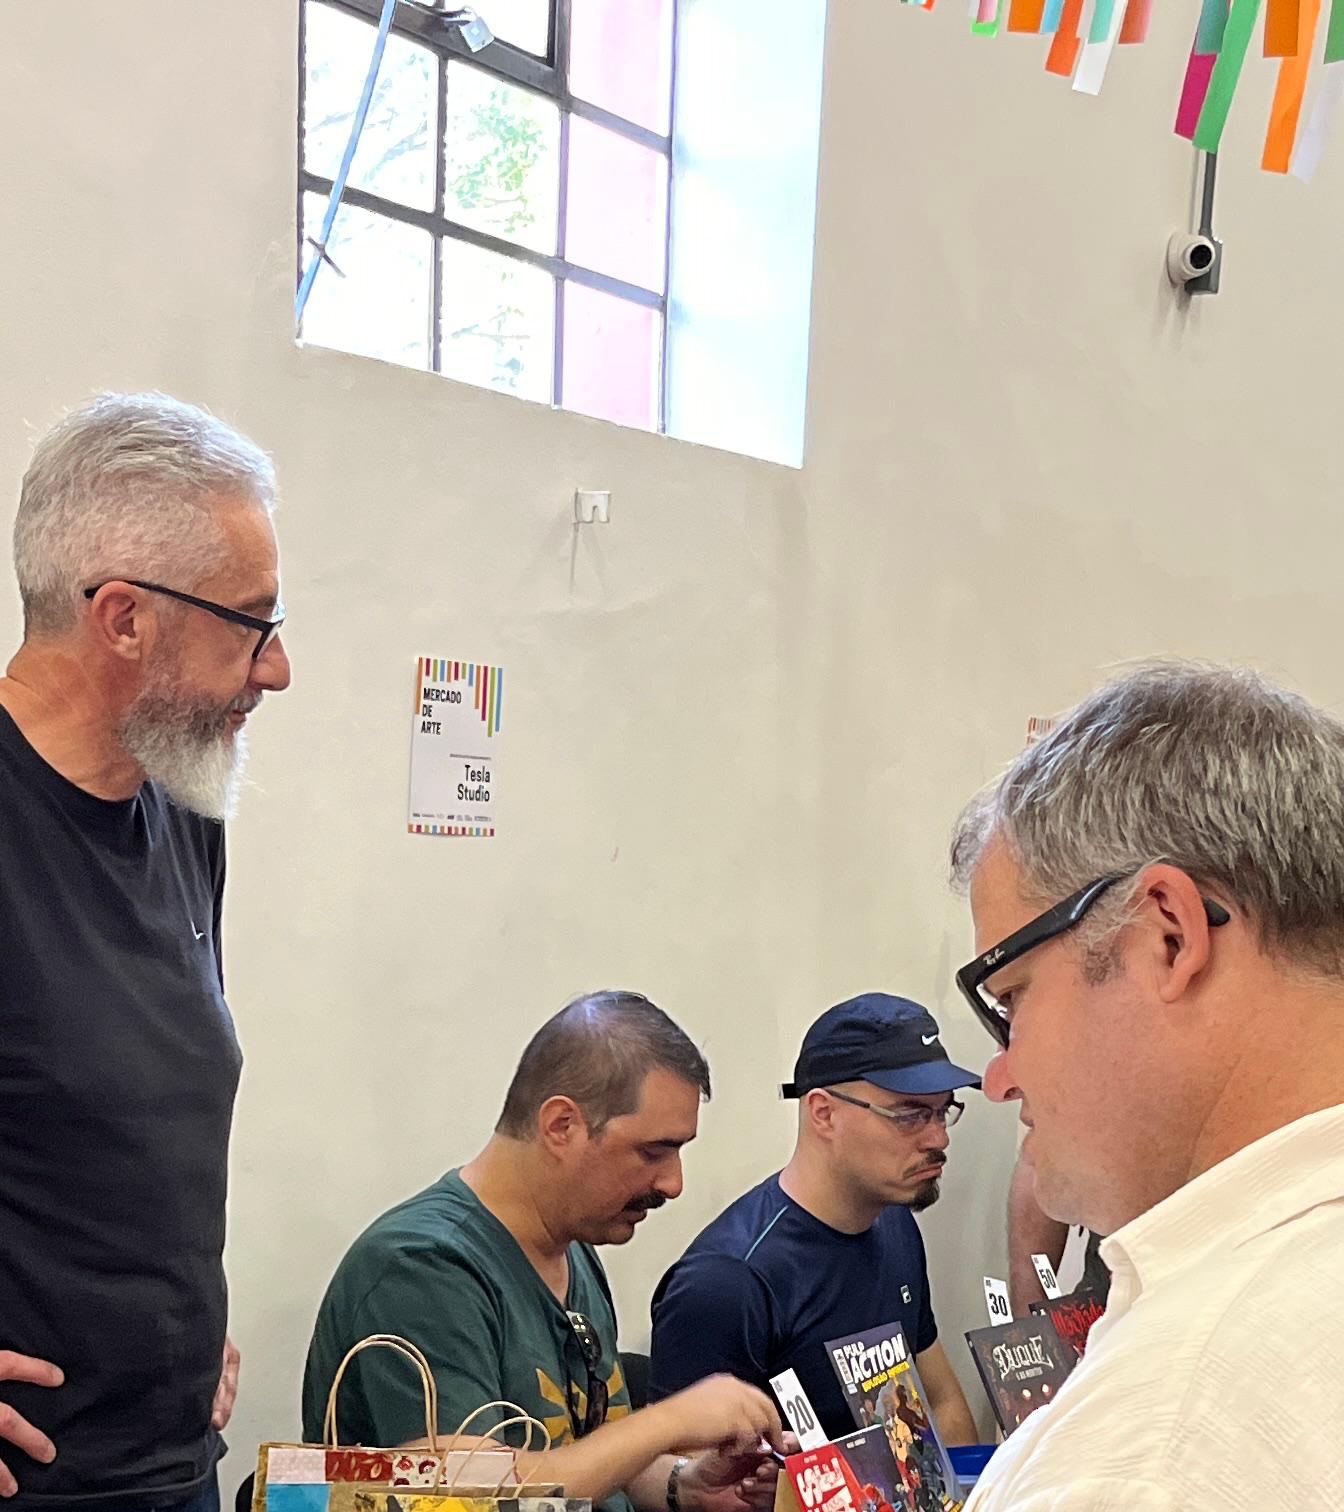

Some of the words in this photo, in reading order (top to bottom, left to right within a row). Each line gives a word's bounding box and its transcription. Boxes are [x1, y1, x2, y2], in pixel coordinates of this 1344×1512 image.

[423, 687, 462, 704] MERCADO
[422, 704, 432, 718] DE
[420, 721, 441, 736] ARTE
[464, 764, 490, 783] Tesla
[457, 783, 490, 802] Studio
[1038, 1268, 1056, 1289] 50
[989, 1293, 1008, 1317] 30
[850, 1333, 907, 1384] ACTION
[787, 1395, 815, 1437] 20
